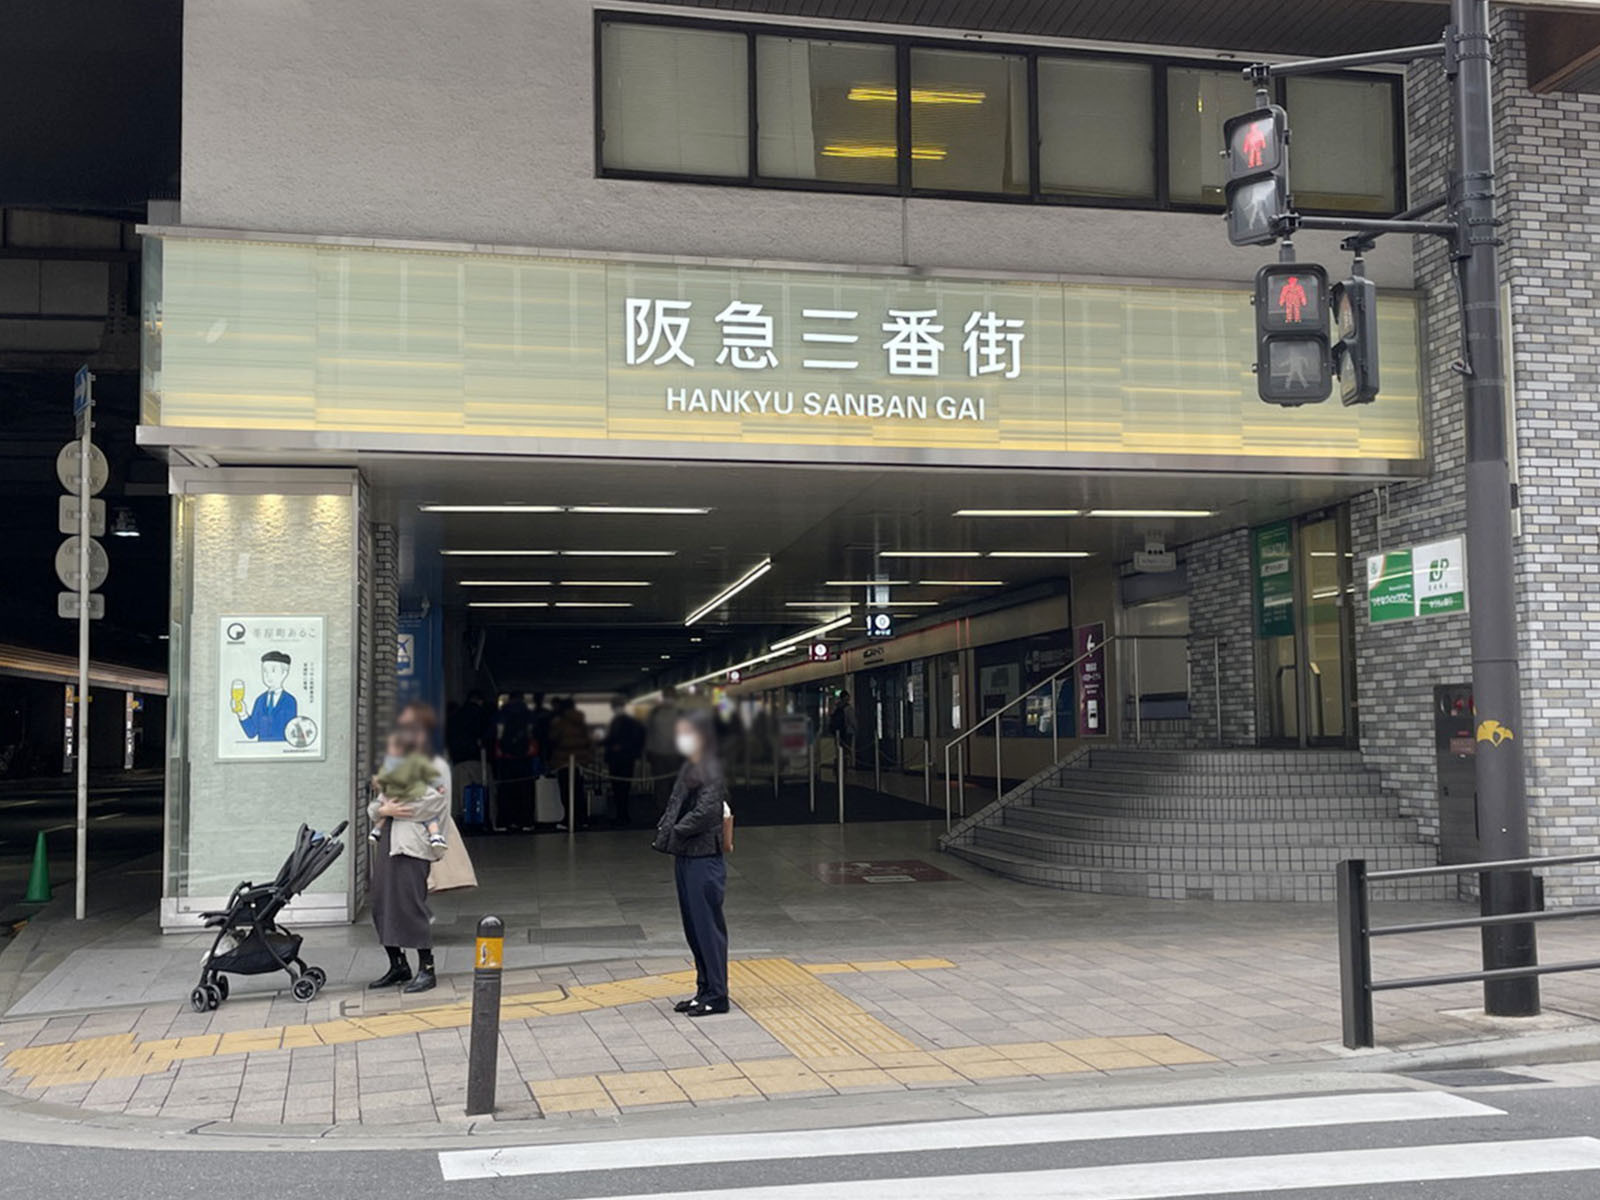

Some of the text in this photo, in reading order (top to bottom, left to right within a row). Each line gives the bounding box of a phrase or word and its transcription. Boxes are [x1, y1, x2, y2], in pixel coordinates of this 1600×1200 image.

[625, 297, 1026, 379] 阪急三番街
[666, 387, 986, 421] HANKYU SANBAN GAI
